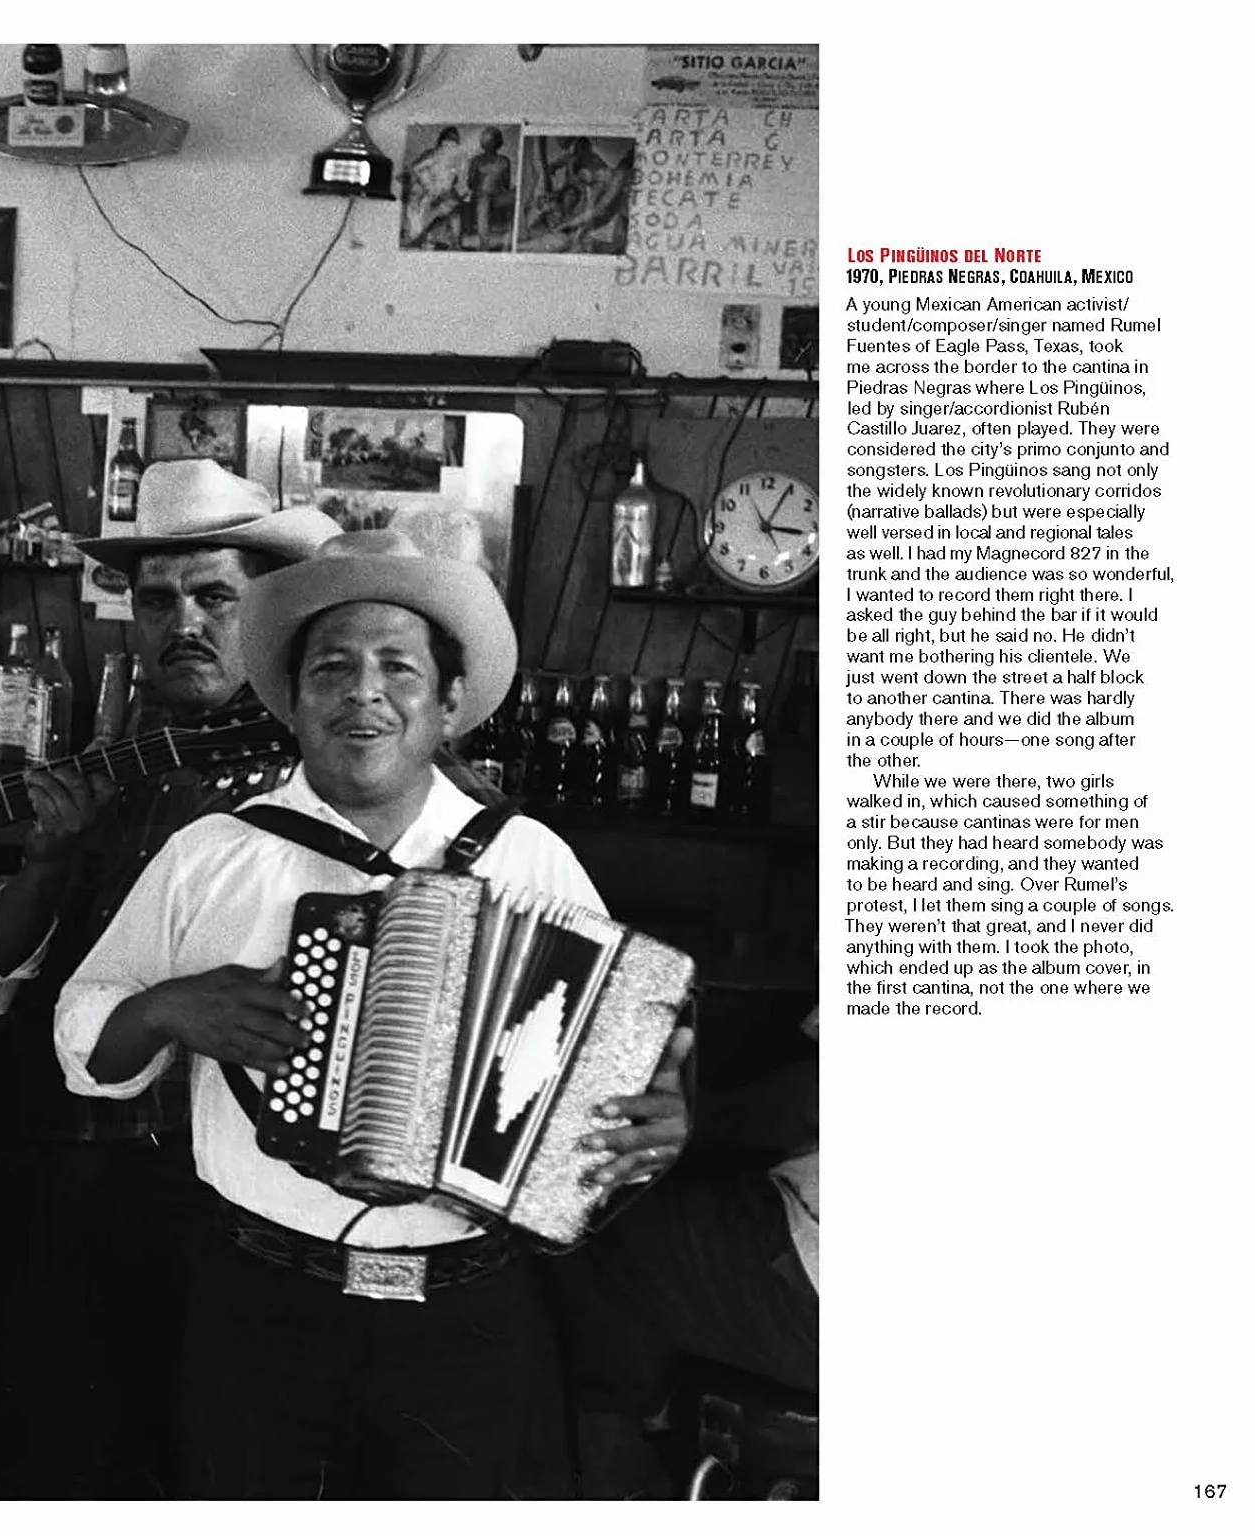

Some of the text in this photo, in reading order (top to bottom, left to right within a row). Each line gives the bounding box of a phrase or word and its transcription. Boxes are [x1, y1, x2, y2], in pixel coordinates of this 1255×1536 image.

[740, 483, 750, 496] 11
[761, 477, 776, 490] 12
[721, 499, 736, 512] 10
[803, 499, 814, 512] 2
[737, 560, 746, 572] 7
[759, 566, 770, 580] 6
